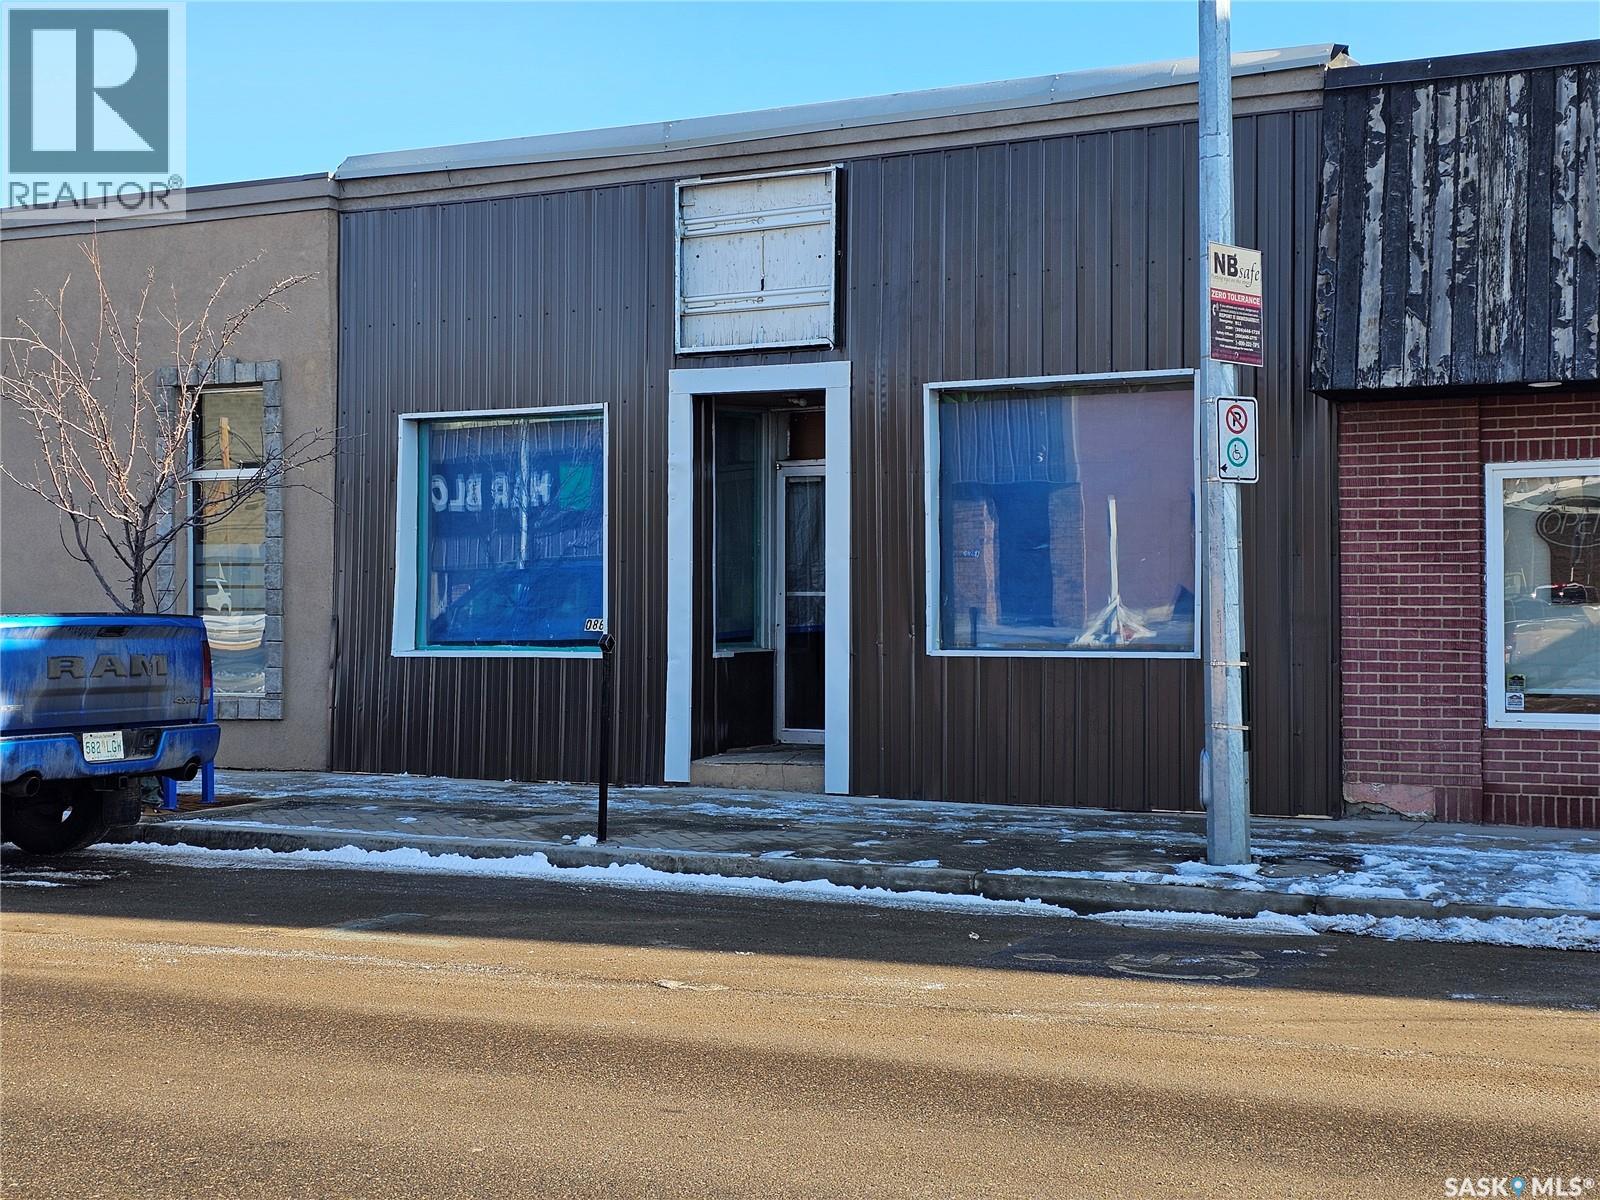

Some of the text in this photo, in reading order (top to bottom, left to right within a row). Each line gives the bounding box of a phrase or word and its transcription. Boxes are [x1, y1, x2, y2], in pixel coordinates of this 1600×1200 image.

[1211, 290, 1261, 305] ZERO TOLERANCE
[1542, 512, 1600, 535] OPE
[46, 653, 168, 680] RAM
[85, 741, 101, 754] 582
